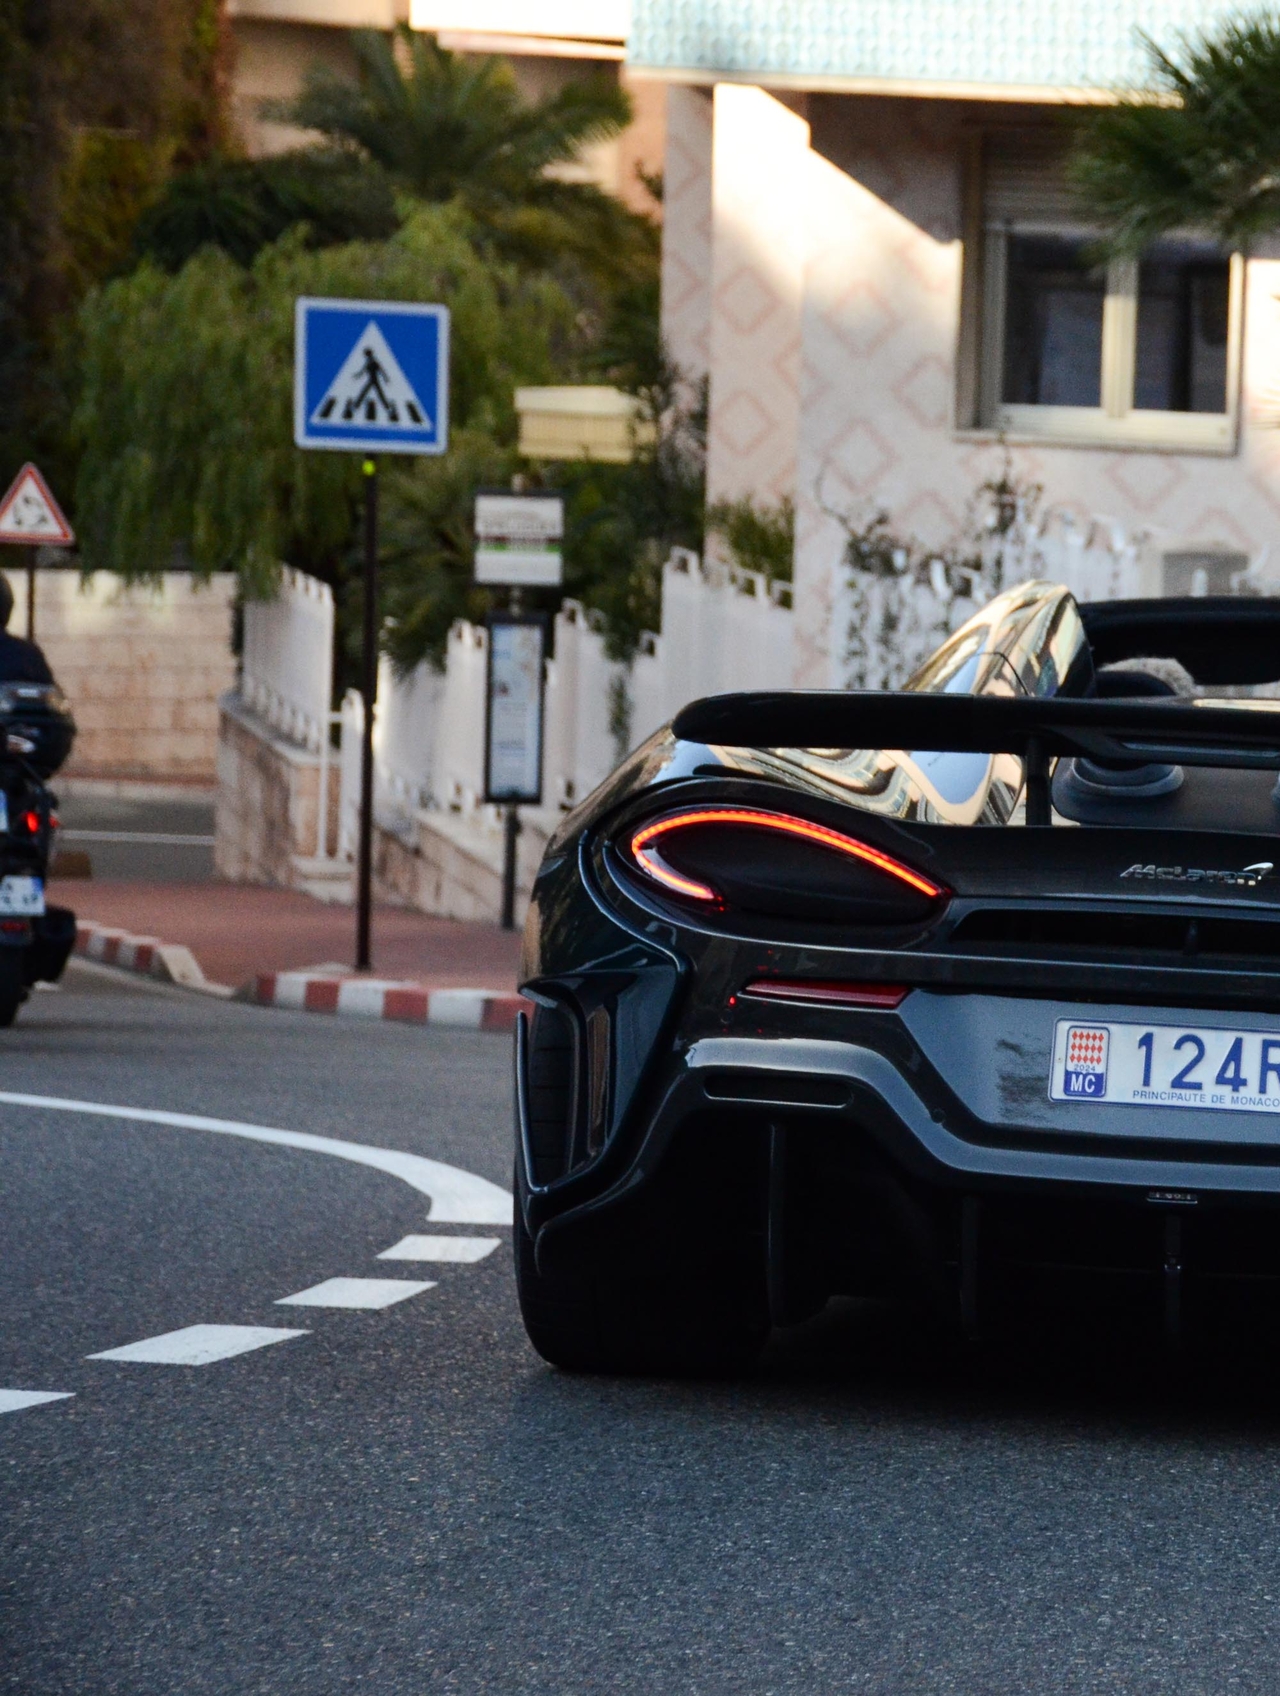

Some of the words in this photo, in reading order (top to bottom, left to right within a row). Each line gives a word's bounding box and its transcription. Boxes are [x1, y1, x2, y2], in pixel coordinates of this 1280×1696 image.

[1120, 864, 1256, 886] McLaren
[1073, 1064, 1096, 1073] 2024
[1070, 1074, 1096, 1094] MC
[1132, 1090, 1206, 1103] PRINCIPAUTE
[1211, 1095, 1226, 1105] DE
[1231, 1096, 1280, 1108] MONACO
